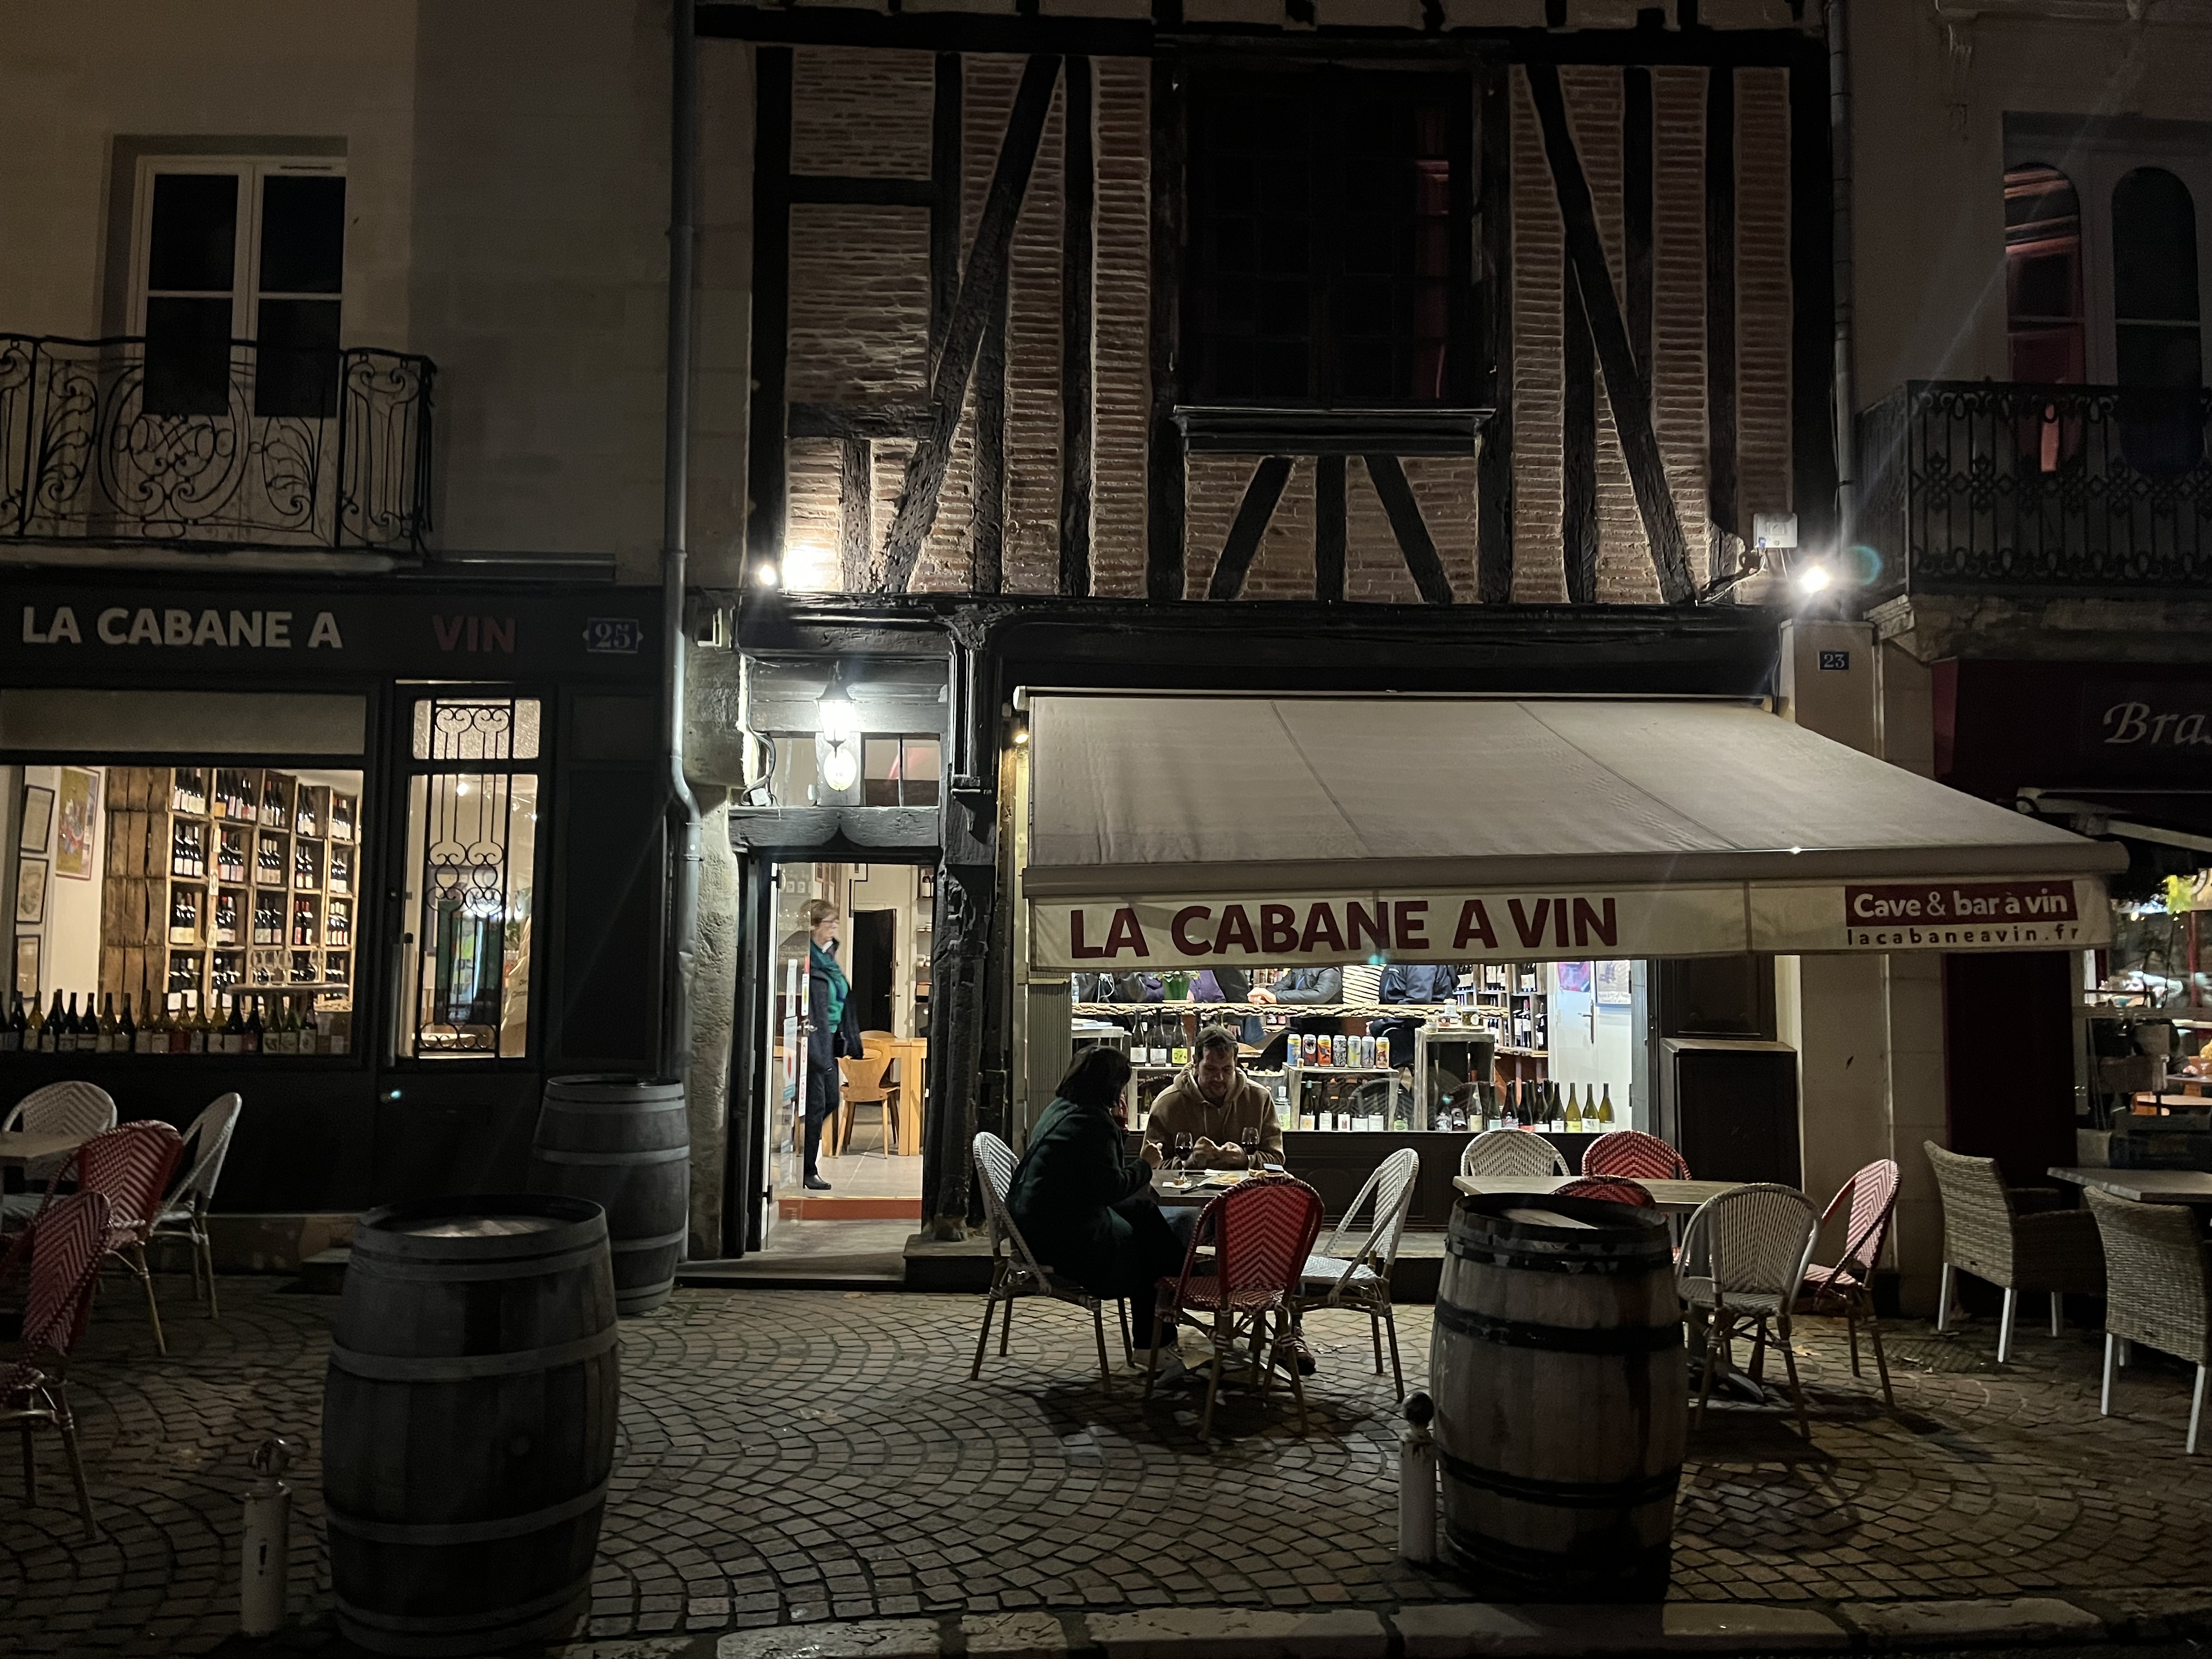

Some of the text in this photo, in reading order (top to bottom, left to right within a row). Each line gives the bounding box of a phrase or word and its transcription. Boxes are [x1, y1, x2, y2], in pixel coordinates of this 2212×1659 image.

[22, 606, 516, 653] LA CABANE A VIN
[595, 623, 631, 648] 25
[1824, 653, 1845, 668] 23
[2103, 702, 2212, 744] Bra
[1854, 888, 2068, 918] Cave & bar à vin
[1070, 898, 1617, 960] LA CABANE A VIN
[1847, 924, 2079, 945] lacabaneavin.fr
